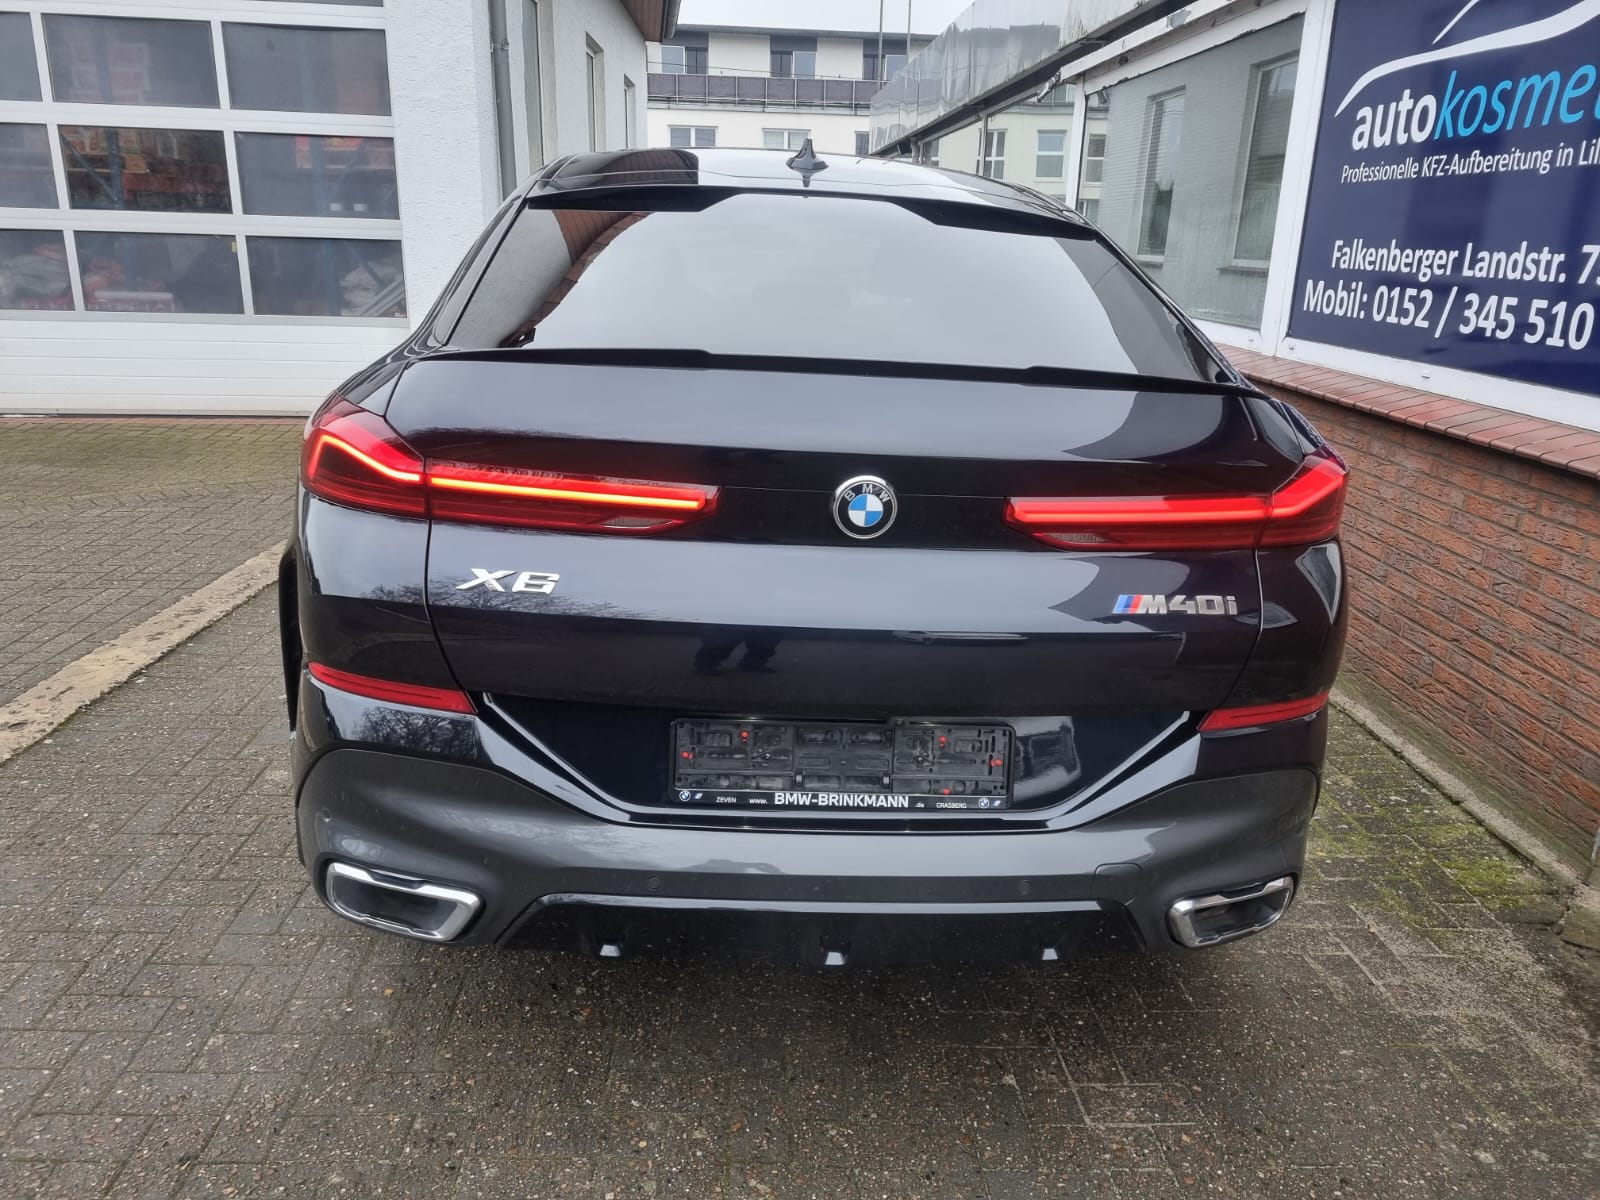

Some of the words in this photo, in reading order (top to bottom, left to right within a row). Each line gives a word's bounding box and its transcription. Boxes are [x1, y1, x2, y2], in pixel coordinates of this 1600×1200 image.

[1352, 64, 1600, 150] autokosme
[1341, 157, 1419, 183] Professionelle
[1421, 149, 1553, 177] KFZ-Aufbereitung
[1556, 142, 1574, 167] in
[1578, 137, 1600, 165] Lil
[1331, 238, 1458, 282] Falkenberger
[1462, 241, 1566, 283] Landstr.
[1578, 244, 1600, 287] 7
[1303, 279, 1368, 319] Mobil:
[1372, 285, 1433, 328] 0152
[1434, 286, 1458, 338] /
[1459, 293, 1518, 340] 345
[1523, 299, 1595, 350] 510
[844, 483, 891, 503] BMW
[455, 567, 560, 595] X6
[1135, 594, 1238, 615] M40i
[774, 792, 909, 809] BMW-BRINKMANN
